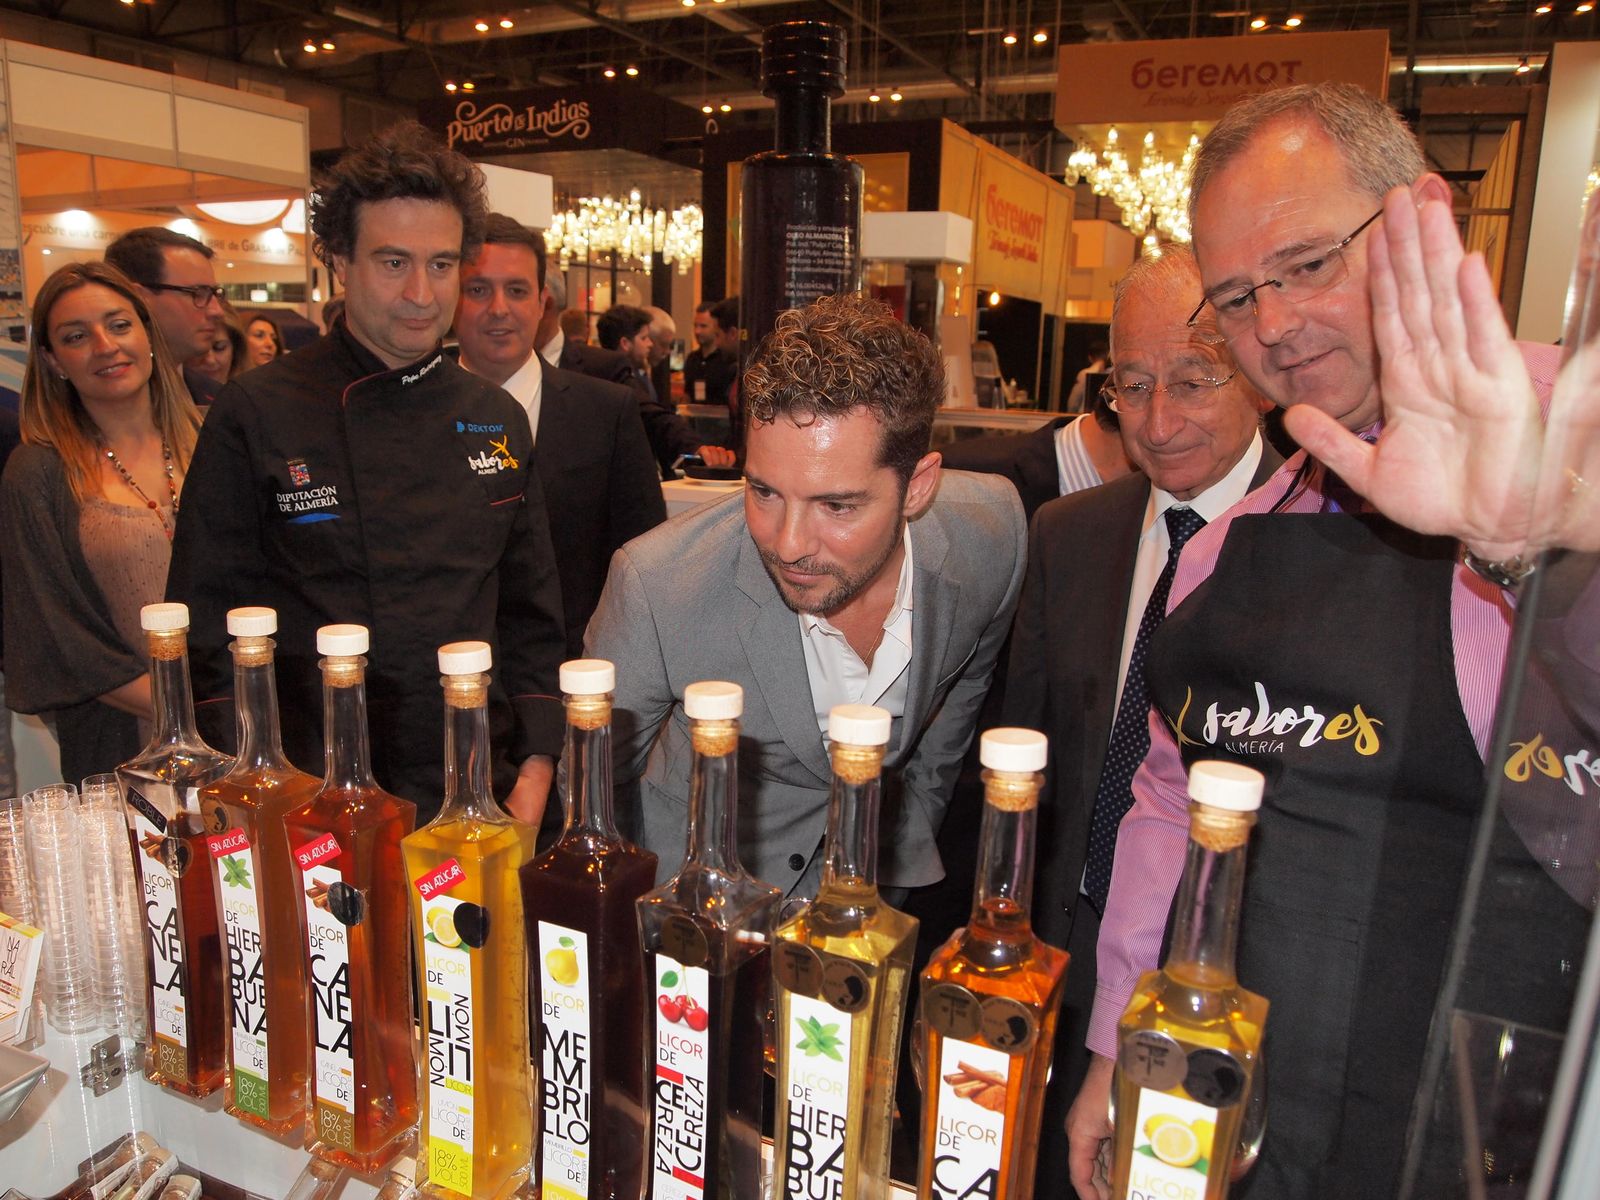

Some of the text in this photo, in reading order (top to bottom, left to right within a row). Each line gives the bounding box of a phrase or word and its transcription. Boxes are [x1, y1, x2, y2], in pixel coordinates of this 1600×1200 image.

[1131, 57, 1302, 90] бегемот
[447, 101, 513, 149] Puerto
[526, 98, 590, 139] Indias
[468, 451, 519, 471] sabores
[276, 486, 337, 503] DIPUTACIÓN
[279, 496, 339, 512] DE ALMERÍA
[1203, 681, 1384, 756] sabores
[1225, 740, 1284, 754] ALMERÍA
[132, 794, 164, 827] ROBLE
[210, 842, 222, 853] SIN
[299, 852, 311, 865] SIN
[144, 871, 173, 891] LICOR
[145, 883, 157, 896] DE
[419, 881, 434, 895] SIN
[224, 897, 256, 918] LICOR
[226, 910, 238, 924] DE
[225, 923, 262, 953] HIER
[309, 923, 345, 945] LICOR
[310, 936, 324, 950] DE
[310, 954, 349, 994] CA
[426, 954, 466, 977] LICOR
[428, 969, 444, 985] DE
[312, 982, 352, 1022] NE
[543, 988, 585, 1013] LICOR
[544, 1002, 560, 1018] DE
[172, 1024, 181, 1035] DE
[314, 1019, 353, 1059] LA
[541, 1022, 587, 1063] ME
[659, 1030, 703, 1060] LICOR
[159, 1043, 177, 1064] 18%
[253, 1057, 264, 1069] DE
[659, 1048, 677, 1066] DE
[239, 1076, 258, 1098] 18%
[445, 1077, 472, 1096] LICOR
[792, 1083, 813, 1102] DE
[793, 1067, 844, 1097] LICOR
[336, 1088, 348, 1101] DE
[542, 1079, 589, 1122] BRI
[320, 1107, 342, 1131] 18%
[431, 1105, 466, 1128] LICOR
[543, 1109, 589, 1145] LLO
[788, 1099, 846, 1140] HIER
[453, 1126, 466, 1140] DE
[938, 1132, 961, 1151] DE
[940, 1116, 997, 1146] LICOR
[434, 1147, 458, 1171] 18%
[567, 1168, 581, 1183] DE
